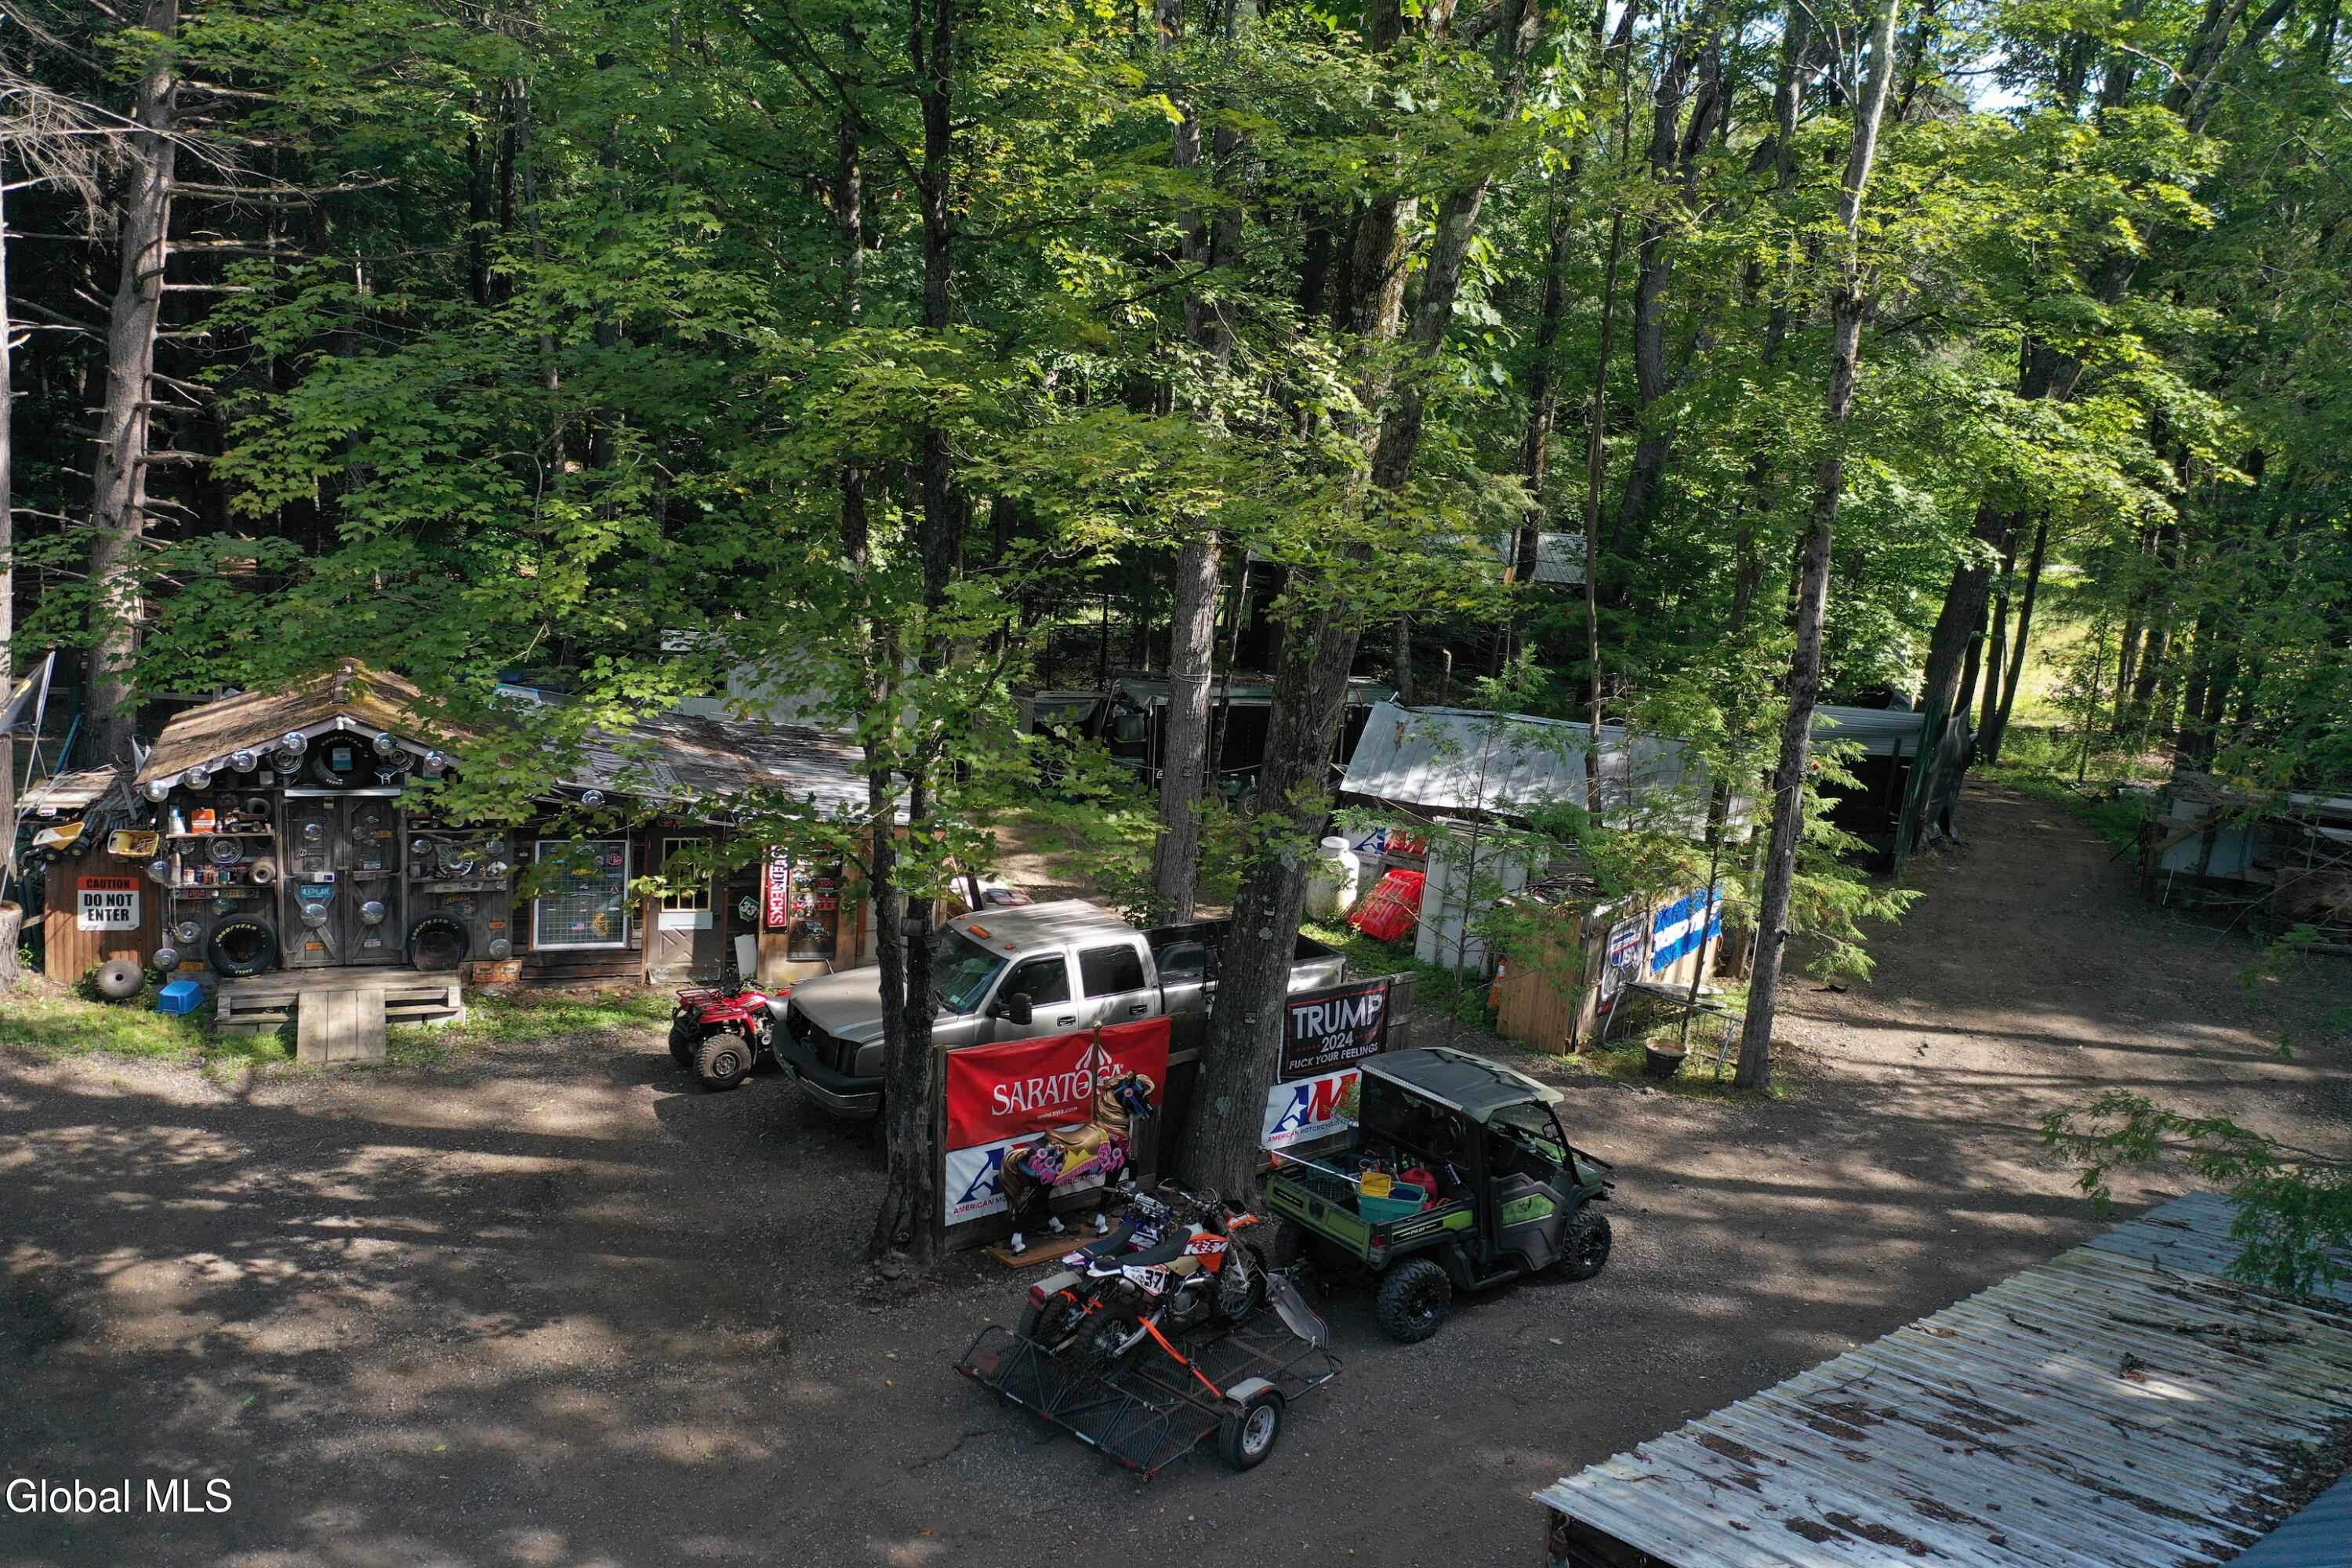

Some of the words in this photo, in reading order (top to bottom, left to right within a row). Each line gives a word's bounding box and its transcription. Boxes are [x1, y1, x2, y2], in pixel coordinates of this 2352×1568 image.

[87, 879, 130, 888] CAUTION
[84, 894, 102, 906] DO
[107, 894, 133, 906] NOT
[88, 909, 129, 921] ENTER
[740, 901, 758, 916] 33
[216, 924, 258, 942] GOODYEAR
[1292, 995, 1383, 1040] TRUMP
[1321, 1031, 1354, 1052] 2024
[1289, 1057, 1314, 1070] FUCK
[1316, 1052, 1339, 1065] YOUR
[1341, 1043, 1378, 1058] FEELINGS
[992, 1064, 1123, 1116] SARATOGA
[1036, 1105, 1078, 1120] www.nyra.com
[1267, 1131, 1300, 1142] AMERICAN
[953, 1199, 994, 1215] AMERICAN
[1184, 1240, 1229, 1255] KTM
[1144, 1269, 1164, 1289] 37
